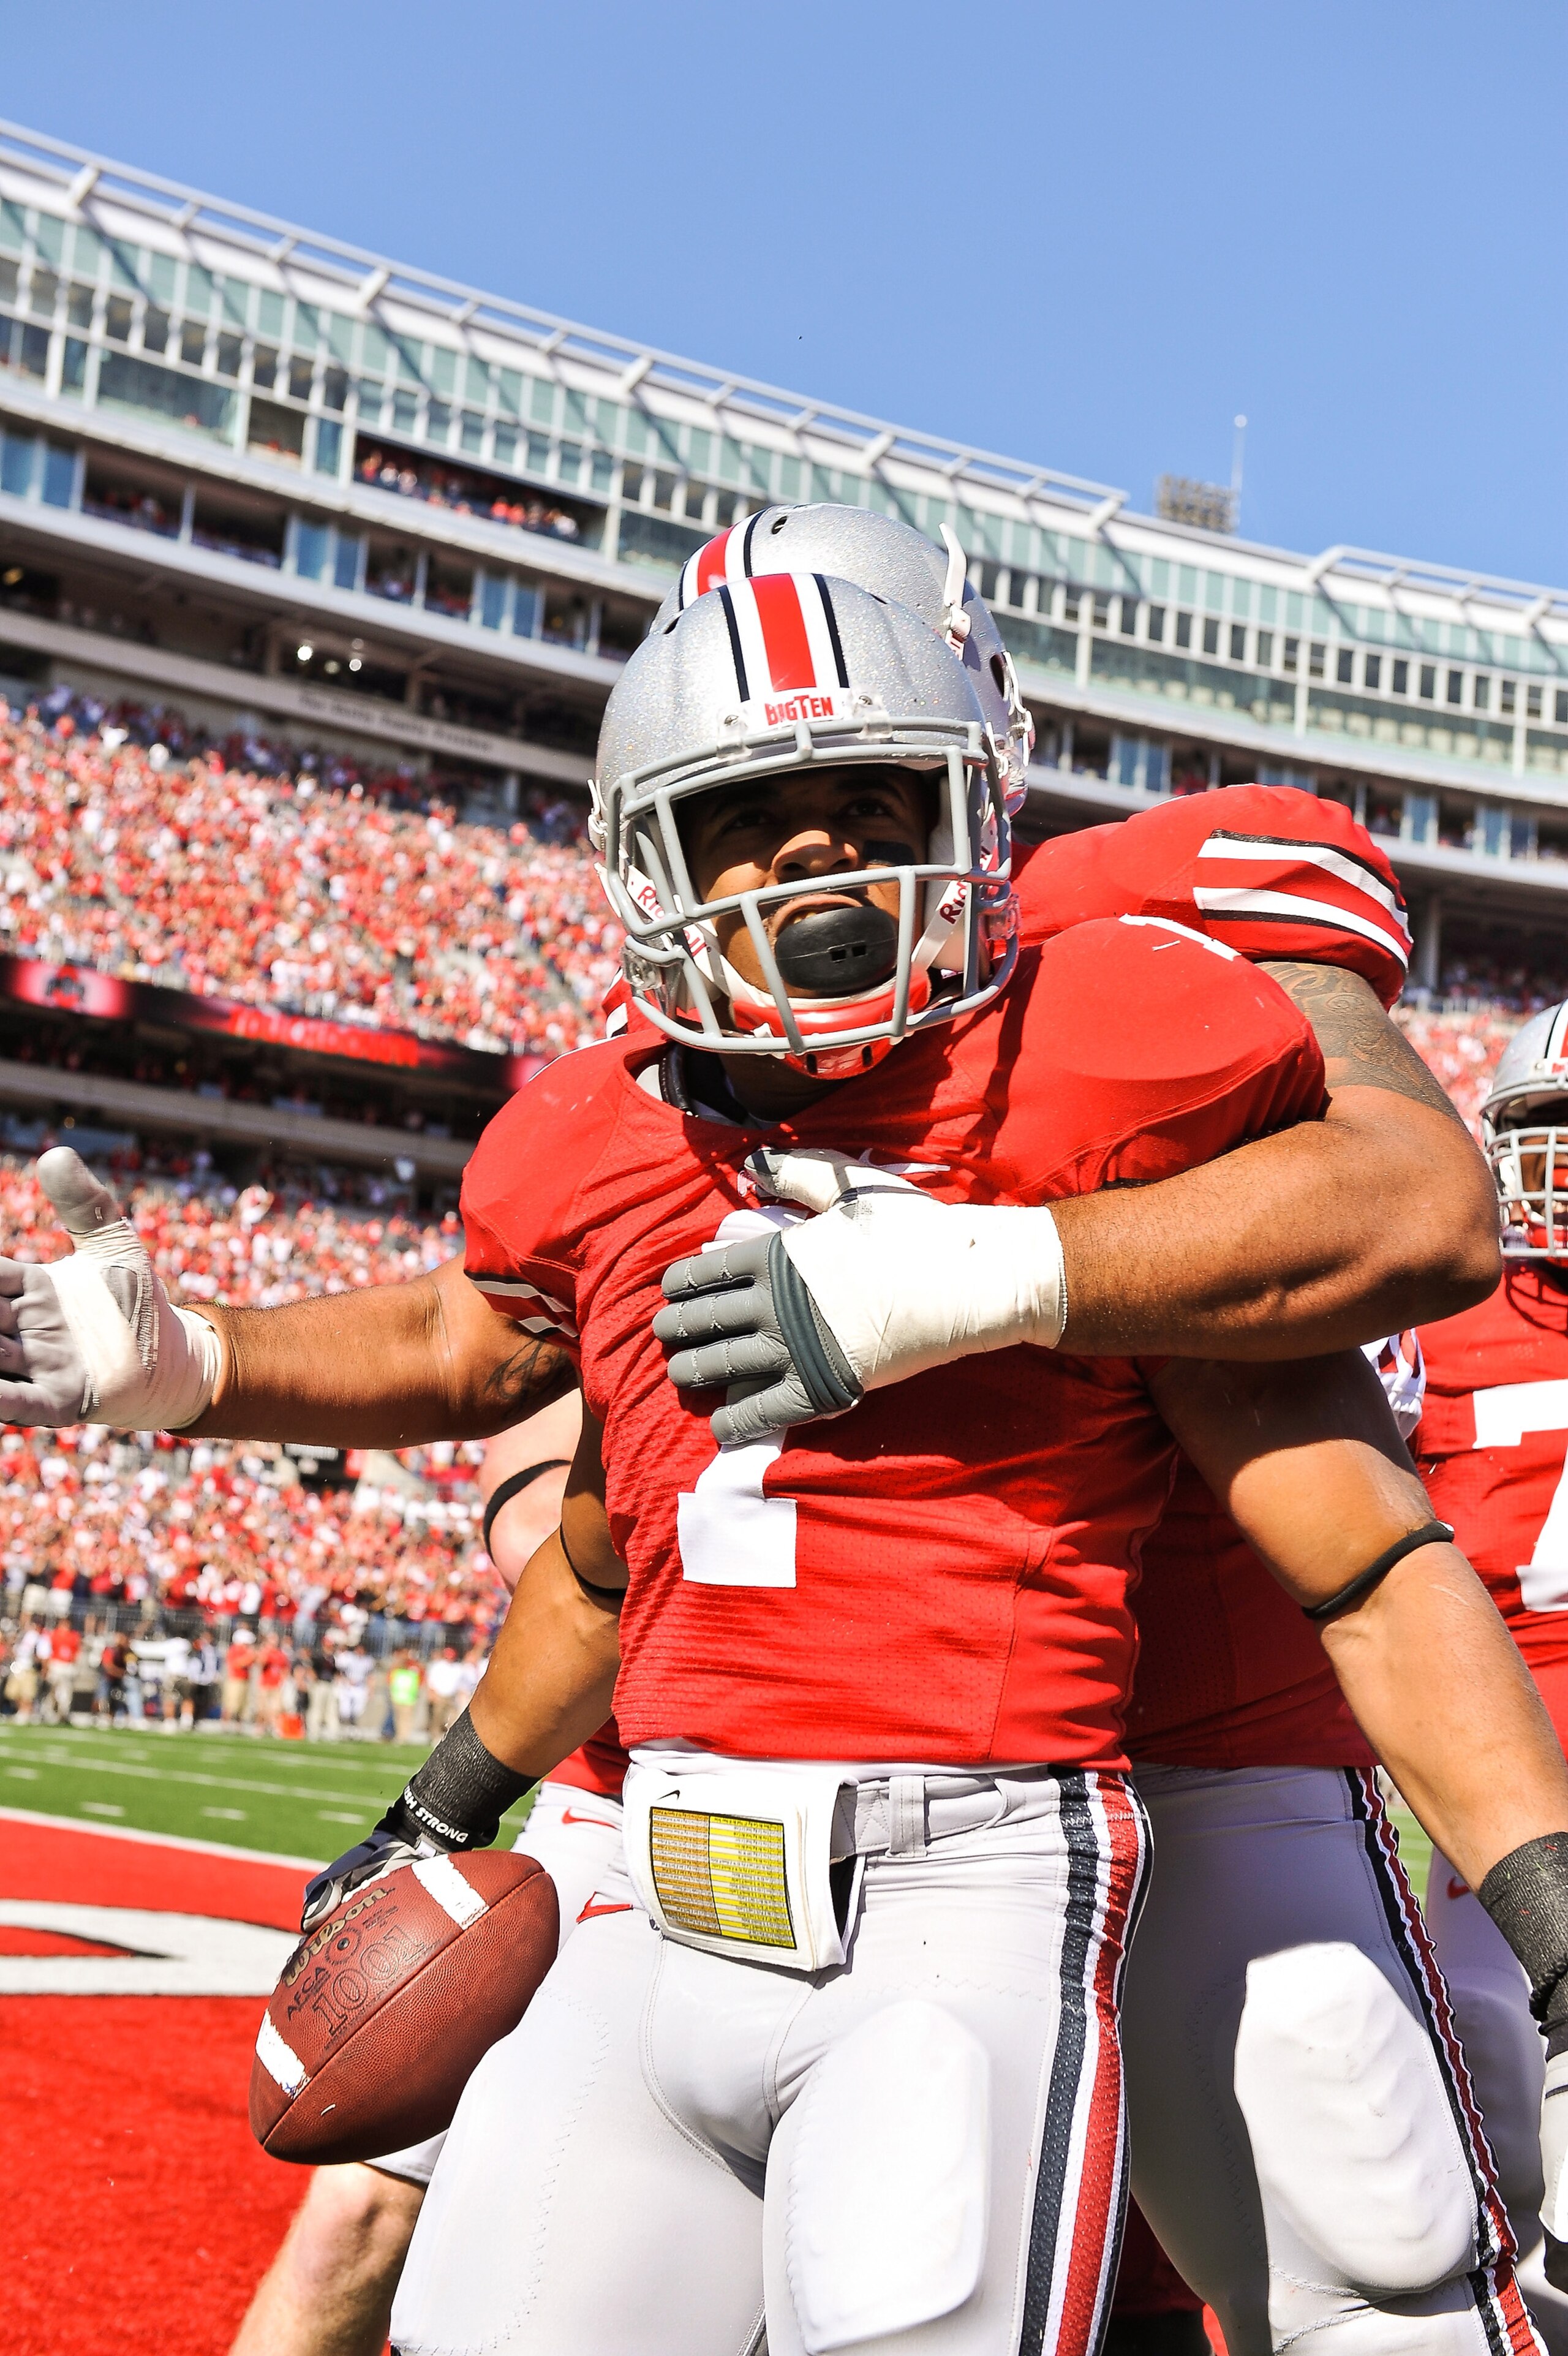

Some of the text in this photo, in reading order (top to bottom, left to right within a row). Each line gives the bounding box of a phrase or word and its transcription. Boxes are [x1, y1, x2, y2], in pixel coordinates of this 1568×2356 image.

[415, 1807, 469, 1843] STRONG
[282, 1887, 389, 1987] Wilson
[287, 1966, 326, 2020] AFCA
[312, 1925, 425, 2037] 1001
